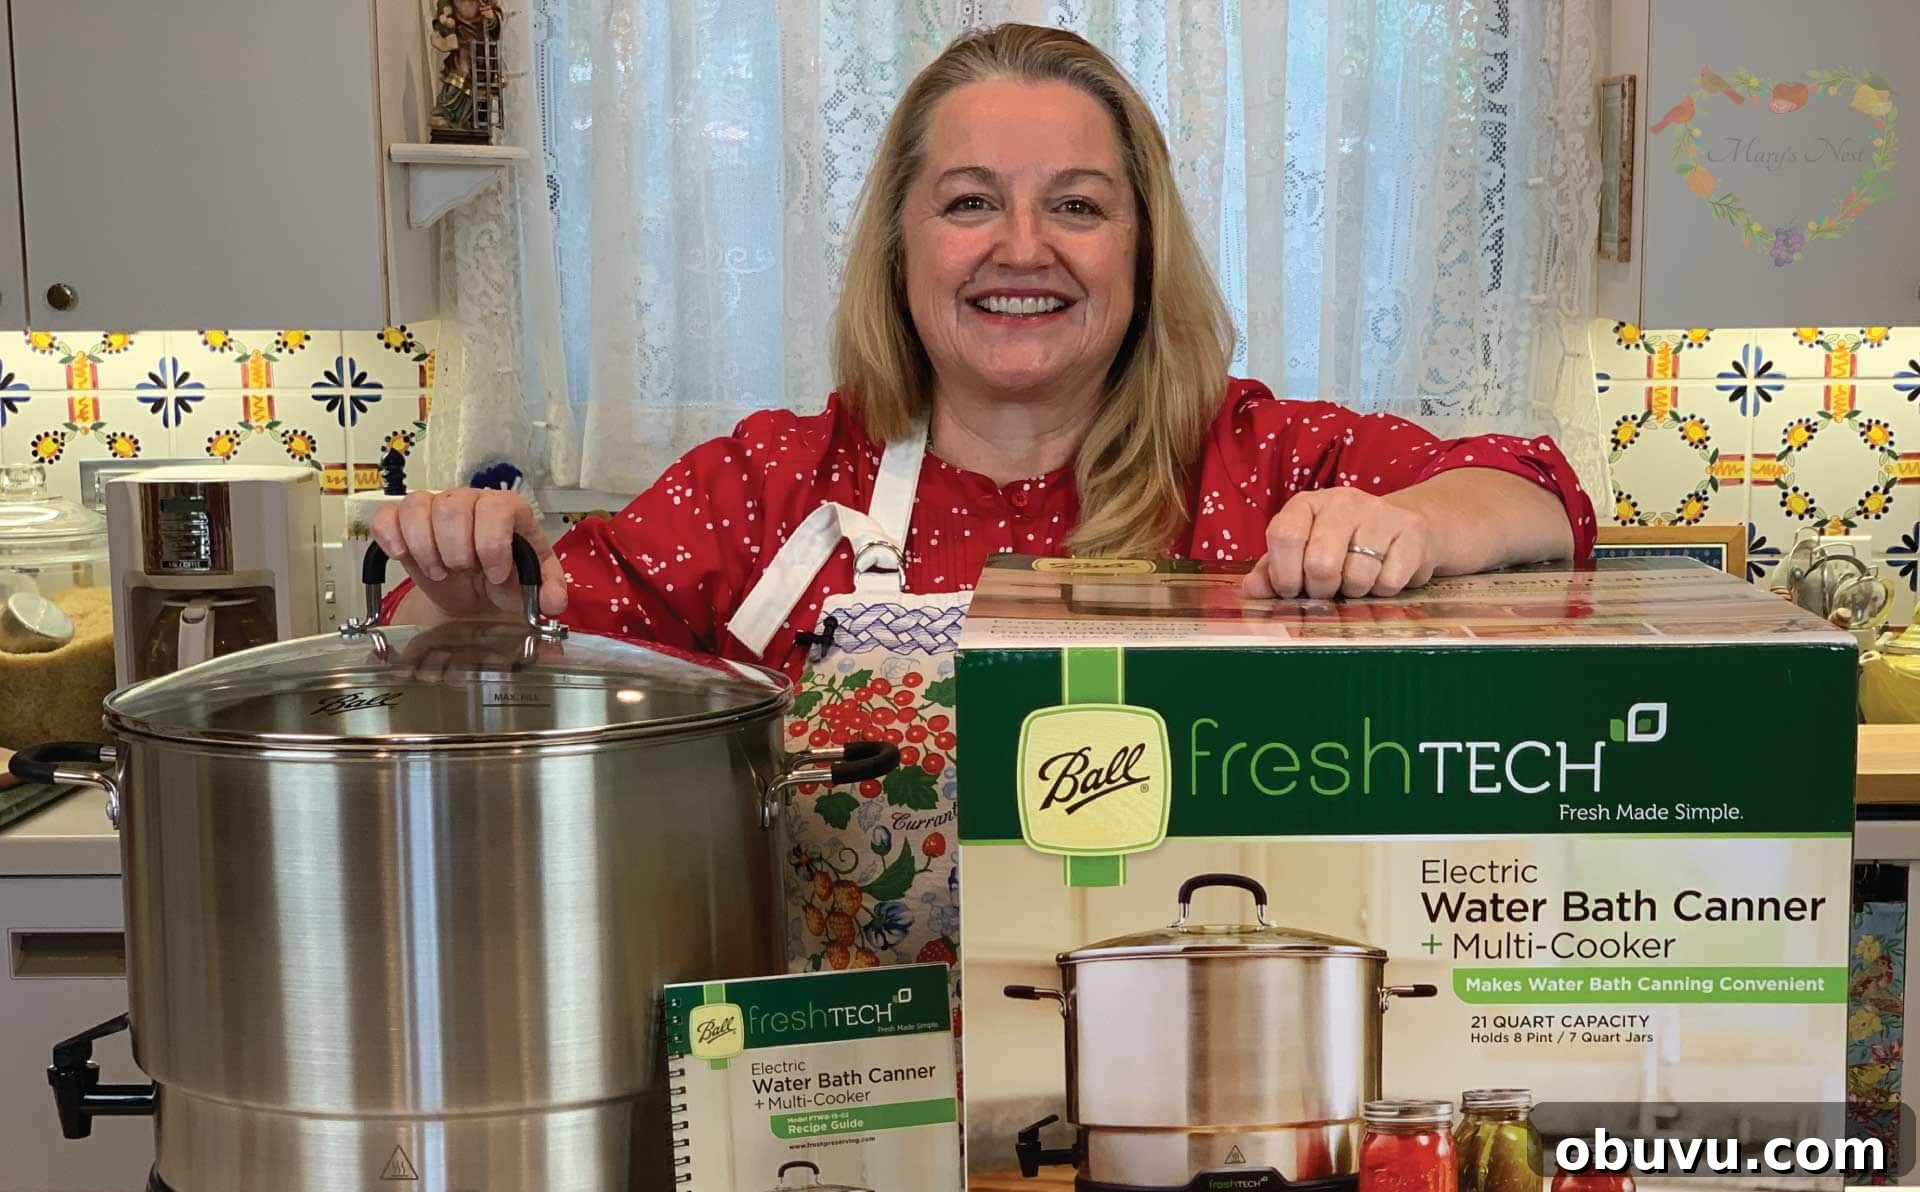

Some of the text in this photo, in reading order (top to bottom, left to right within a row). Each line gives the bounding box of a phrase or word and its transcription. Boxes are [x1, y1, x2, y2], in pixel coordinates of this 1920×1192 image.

[310, 691, 402, 716] Ball
[1190, 716, 1607, 796] freshTECH
[1038, 742, 1151, 815] Ball
[1559, 804, 1744, 824] Fresh Made Simple.
[1421, 859, 1538, 885] Electric
[1421, 890, 1826, 923] Water Bath Canner
[1421, 932, 1676, 959] + Multi-Cooker
[1466, 976, 1825, 995] Makes Water Bath Canning Convenient
[697, 1016, 736, 1044] Ball
[749, 1002, 893, 1034] freshTECH
[1470, 1015, 1650, 1030] 21 QUART CAPACITY
[1470, 1032, 1511, 1044] Holds
[1514, 1032, 1523, 1044] 8
[1526, 1032, 1553, 1044] Pint
[1568, 1032, 1577, 1044] 7
[1581, 1032, 1621, 1044] Quart
[1625, 1032, 1654, 1044] Jars
[751, 1060, 806, 1075] Electric
[753, 1064, 936, 1094] Water Bath Canner
[754, 1089, 871, 1111] + Multi-Cooker
[788, 1117, 865, 1136] Recipe Guide
